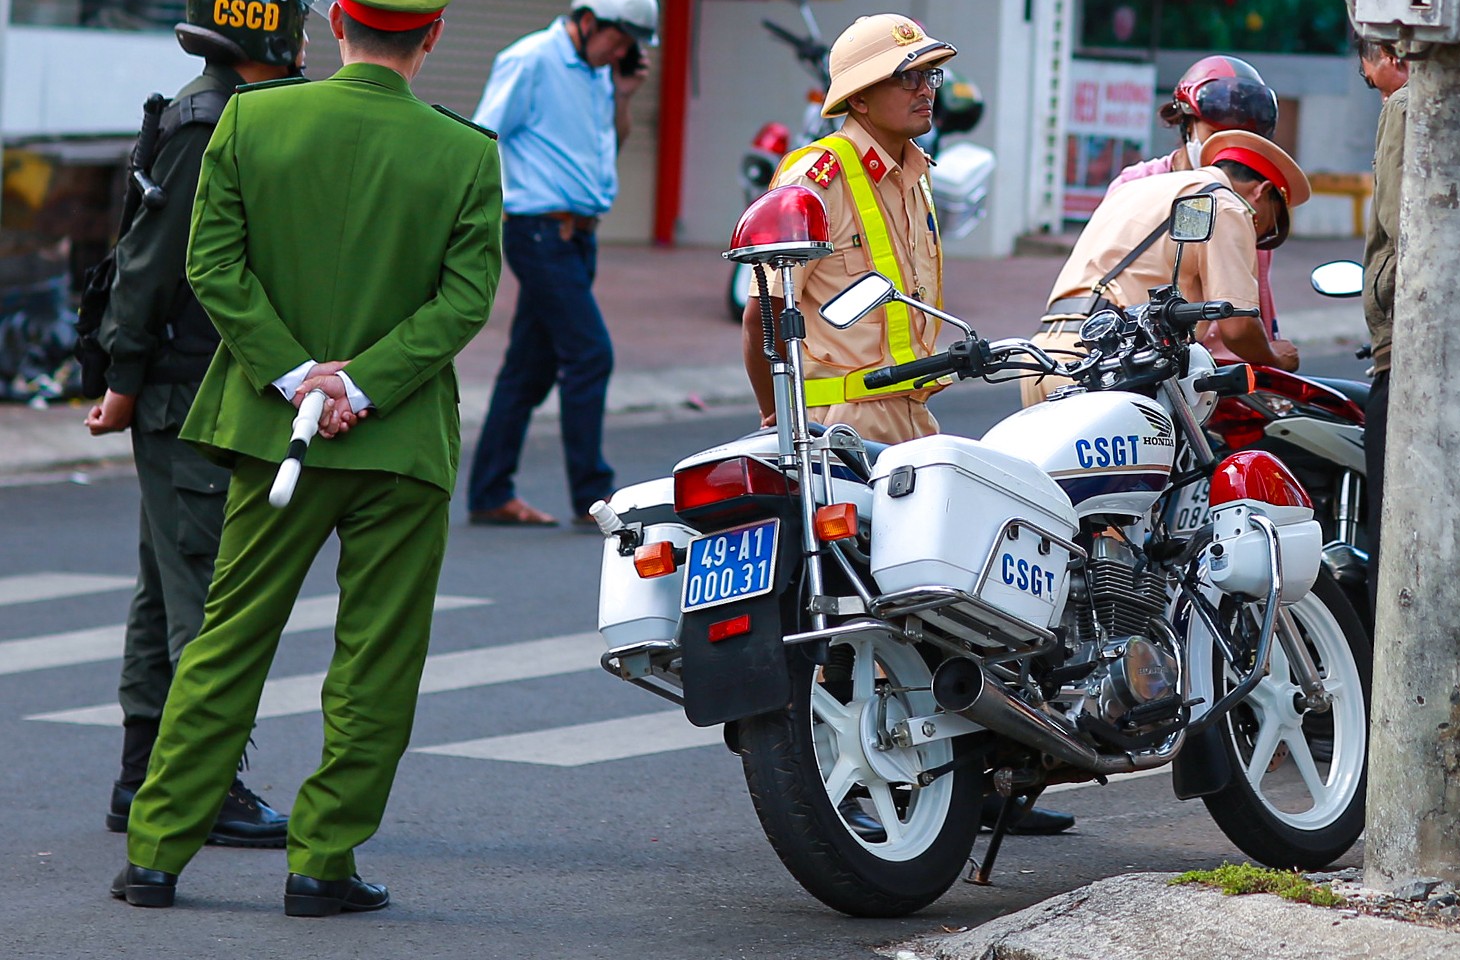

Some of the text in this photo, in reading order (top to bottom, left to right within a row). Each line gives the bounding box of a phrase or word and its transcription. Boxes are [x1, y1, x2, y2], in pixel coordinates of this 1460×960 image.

[1075, 435, 1139, 469] CSGT
[1143, 436, 1175, 448] HONDA
[701, 527, 764, 569] 49-A1
[688, 549, 768, 606] 000.31
[1002, 552, 1055, 602] CSGT
